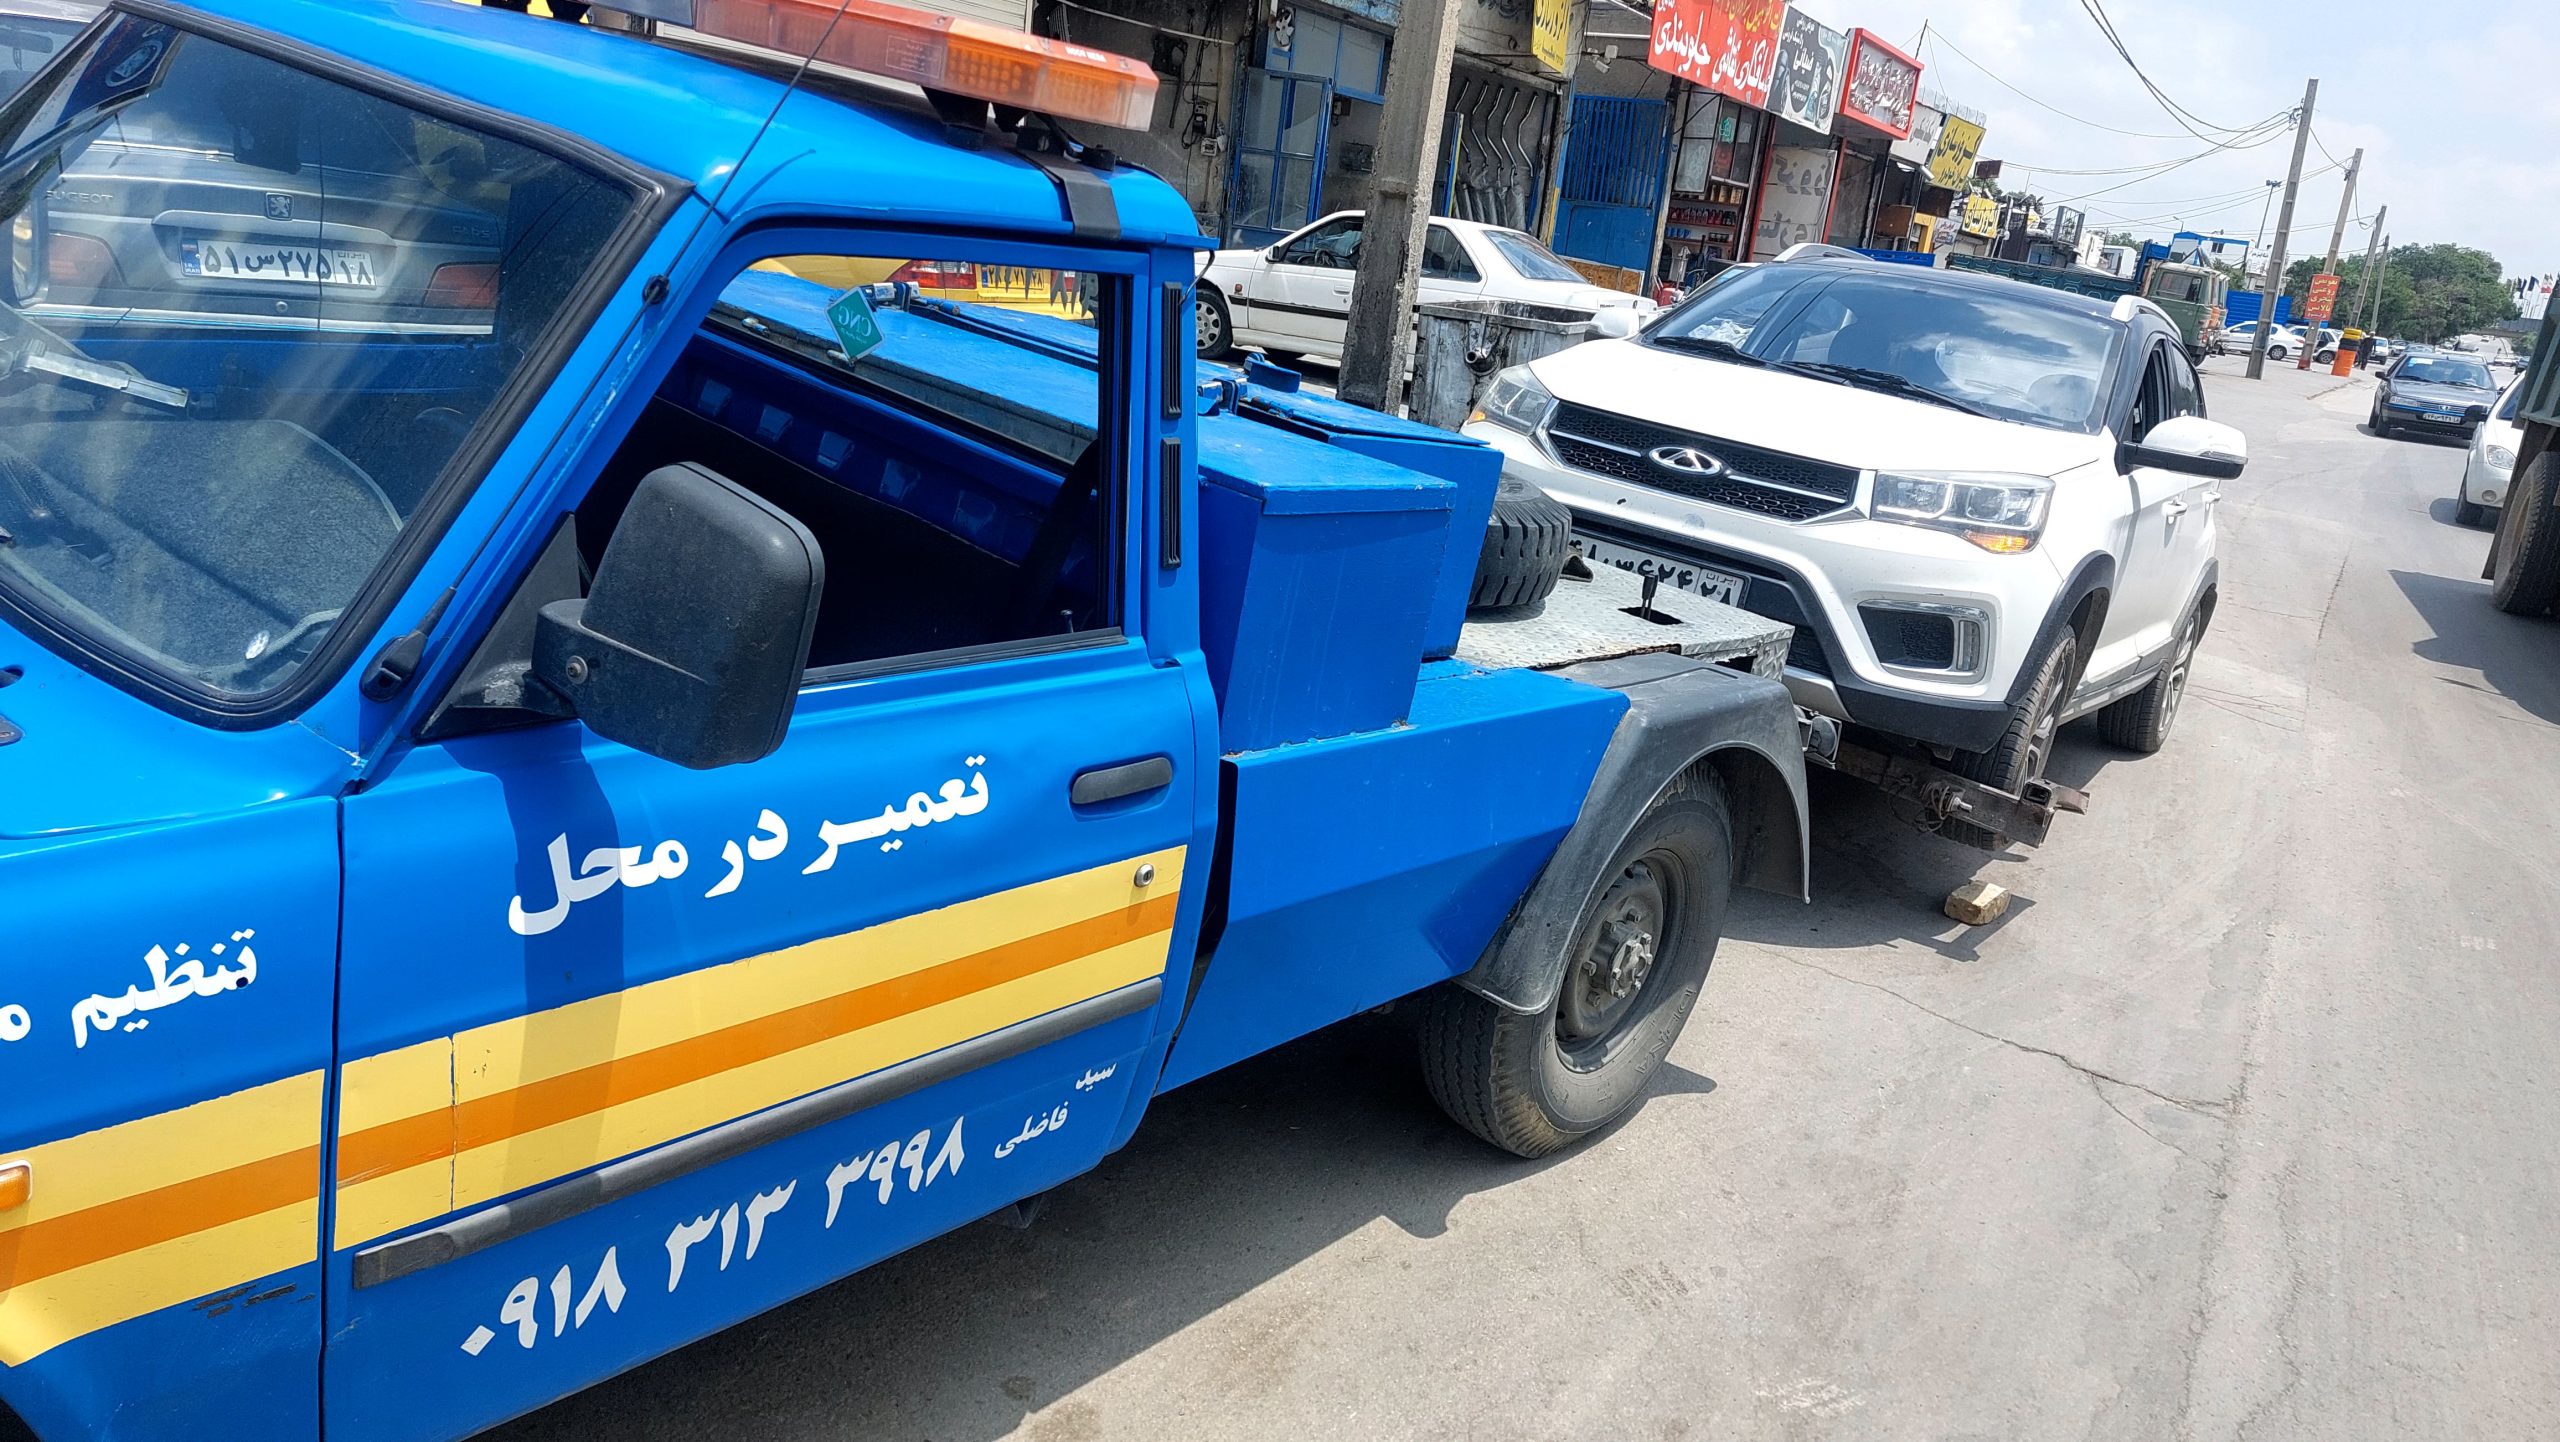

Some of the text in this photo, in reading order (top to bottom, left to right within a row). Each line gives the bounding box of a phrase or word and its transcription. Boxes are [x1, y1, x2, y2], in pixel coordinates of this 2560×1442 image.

[1654, 10, 1711, 77] جلوبندی
[507, 754, 990, 936] تعمیر در محل
[71, 928, 258, 1049] تنظیم
[1075, 1062, 1117, 1092] سید
[461, 1116, 965, 1357] ۰۹۱۸ ۳۱۳ ۳۹۹۸
